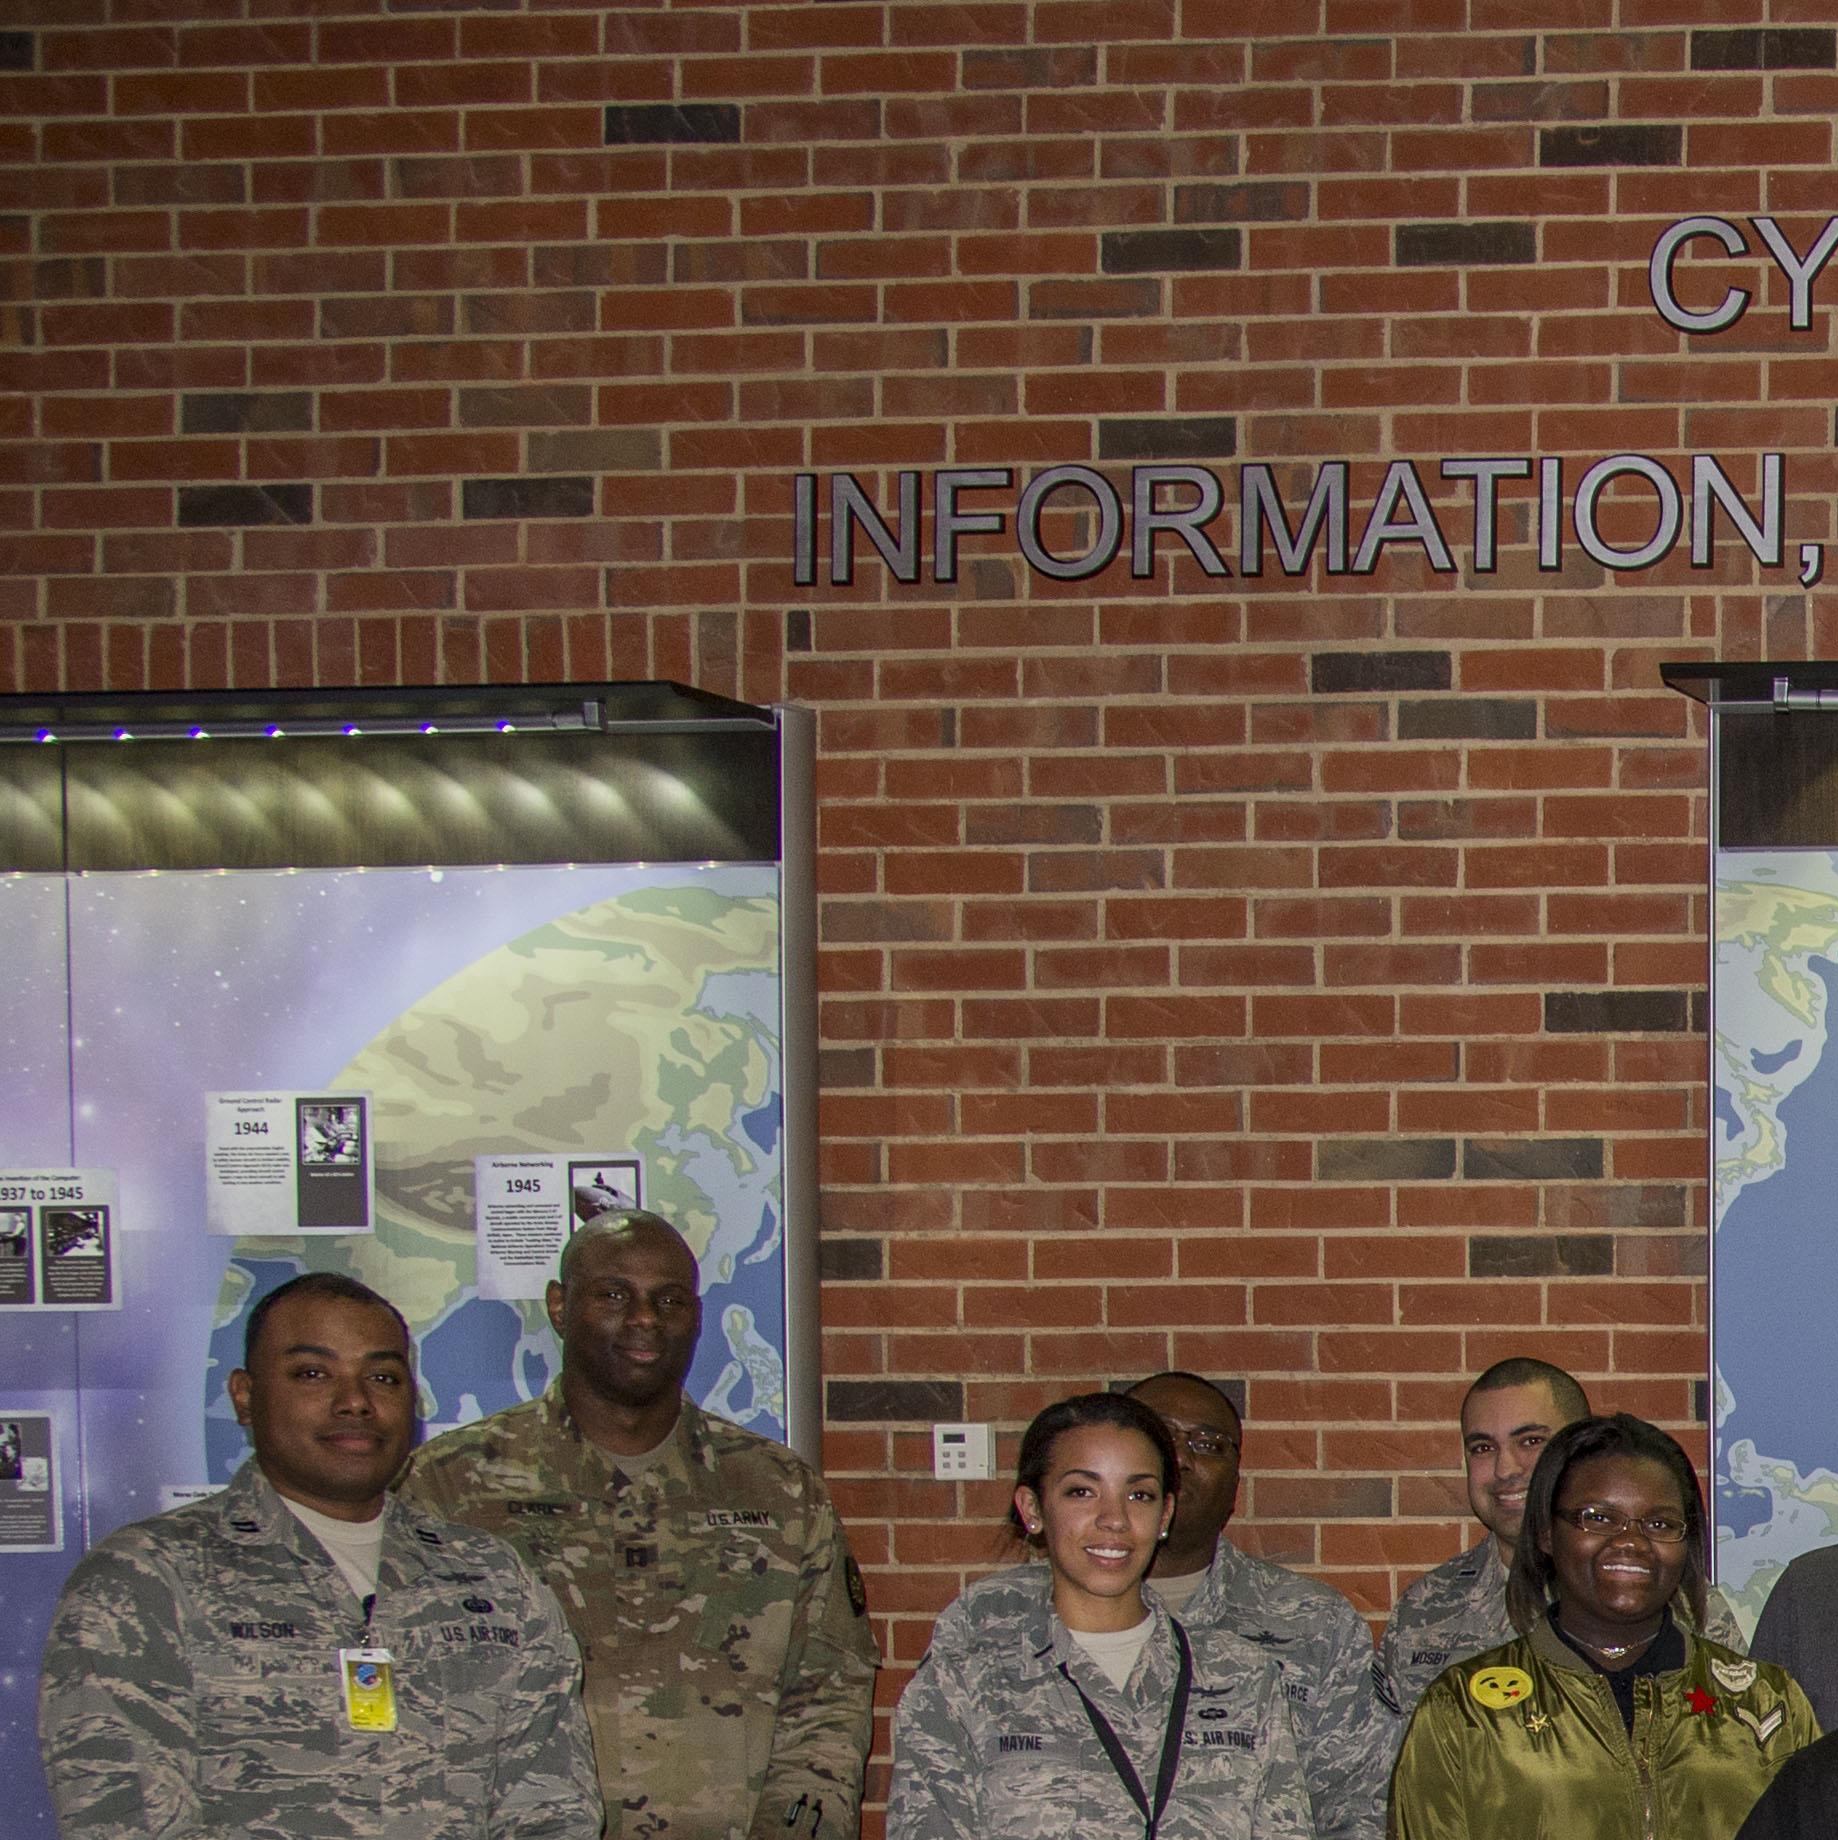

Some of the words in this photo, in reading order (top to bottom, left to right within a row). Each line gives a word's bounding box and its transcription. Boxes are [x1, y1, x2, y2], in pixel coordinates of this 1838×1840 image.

[790, 450, 1822, 587] INFORMATION,
[234, 1122, 269, 1136] 1944
[30, 1188, 45, 1200] to
[50, 1187, 84, 1200] 1945
[506, 1179, 541, 1193] 1945
[732, 1511, 770, 1526] ARMY
[469, 1625, 492, 1641] AIR
[1411, 1651, 1450, 1665] MOSBY
[1000, 1736, 1042, 1752] MAYNE
[1203, 1730, 1224, 1746] AIR
[1228, 1731, 1256, 1750] FORCE
